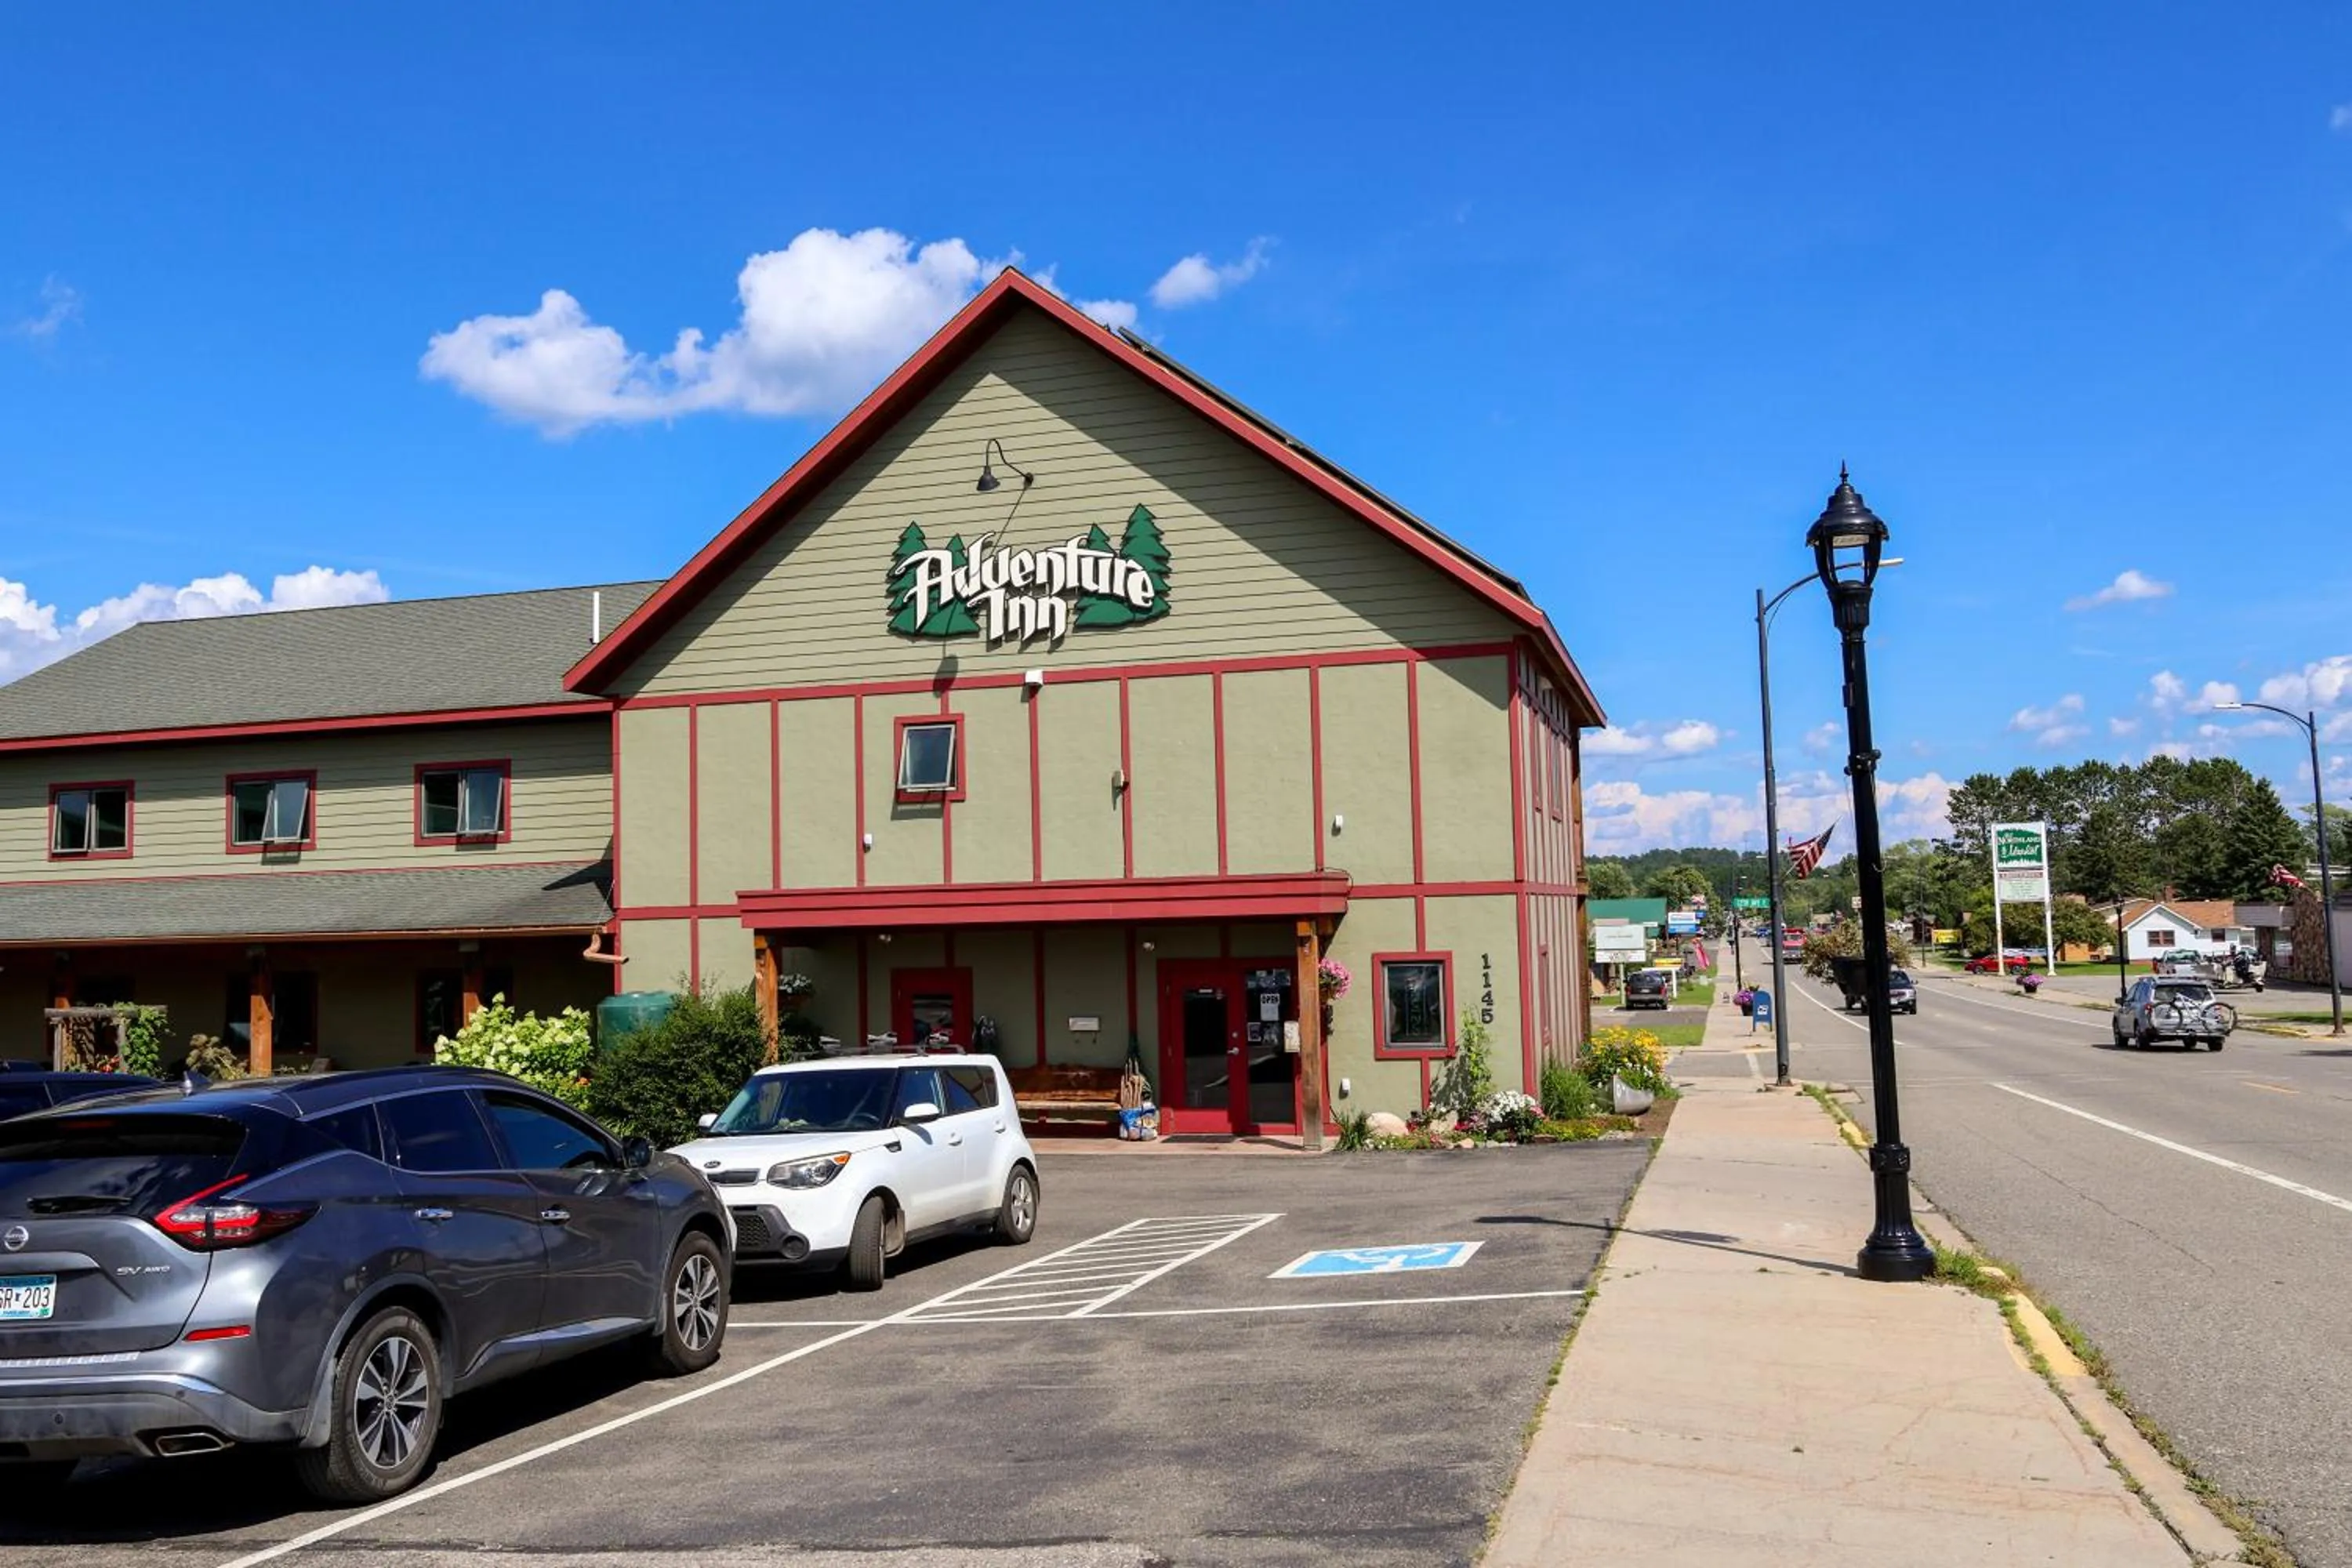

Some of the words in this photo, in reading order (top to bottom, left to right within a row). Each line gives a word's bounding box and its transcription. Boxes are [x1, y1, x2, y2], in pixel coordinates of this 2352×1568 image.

[895, 530, 1155, 630] Adventure
[967, 587, 1068, 642] Inn
[1260, 994, 1279, 1004] OPEN
[1480, 953, 1494, 1024] 1145
[23, 1287, 51, 1308] 203
